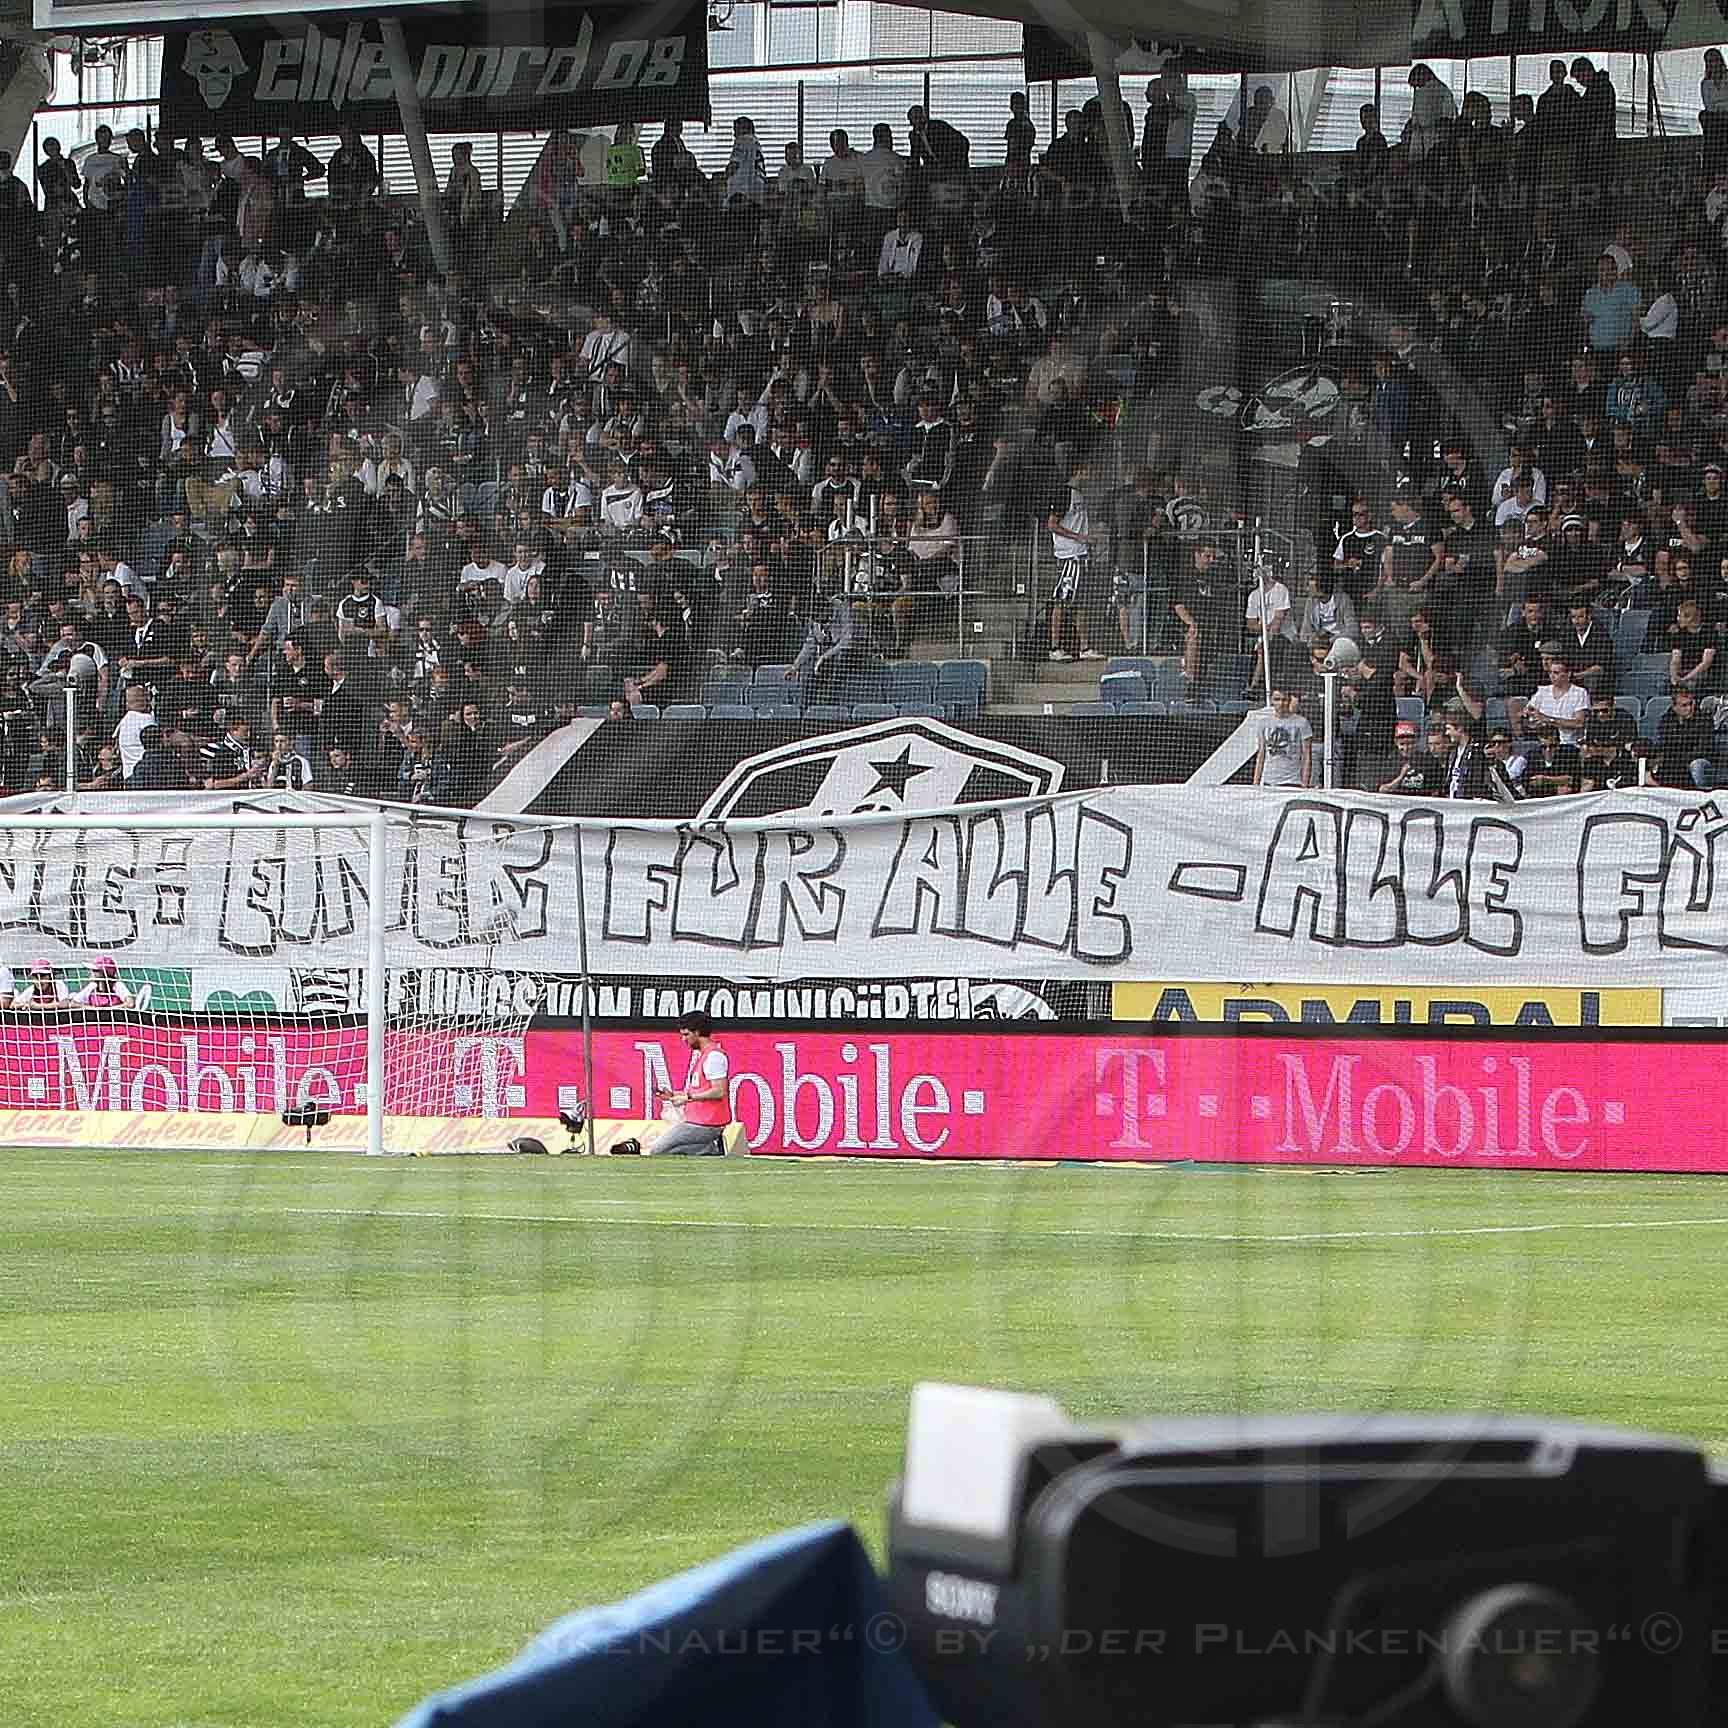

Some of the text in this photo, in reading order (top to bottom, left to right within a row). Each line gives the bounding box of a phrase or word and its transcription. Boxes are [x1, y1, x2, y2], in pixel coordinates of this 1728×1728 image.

[217, 800, 554, 957] EINER
[602, 819, 847, 952] FÜR
[871, 801, 1134, 965] ALLE
[1254, 800, 1524, 957] ALLE
